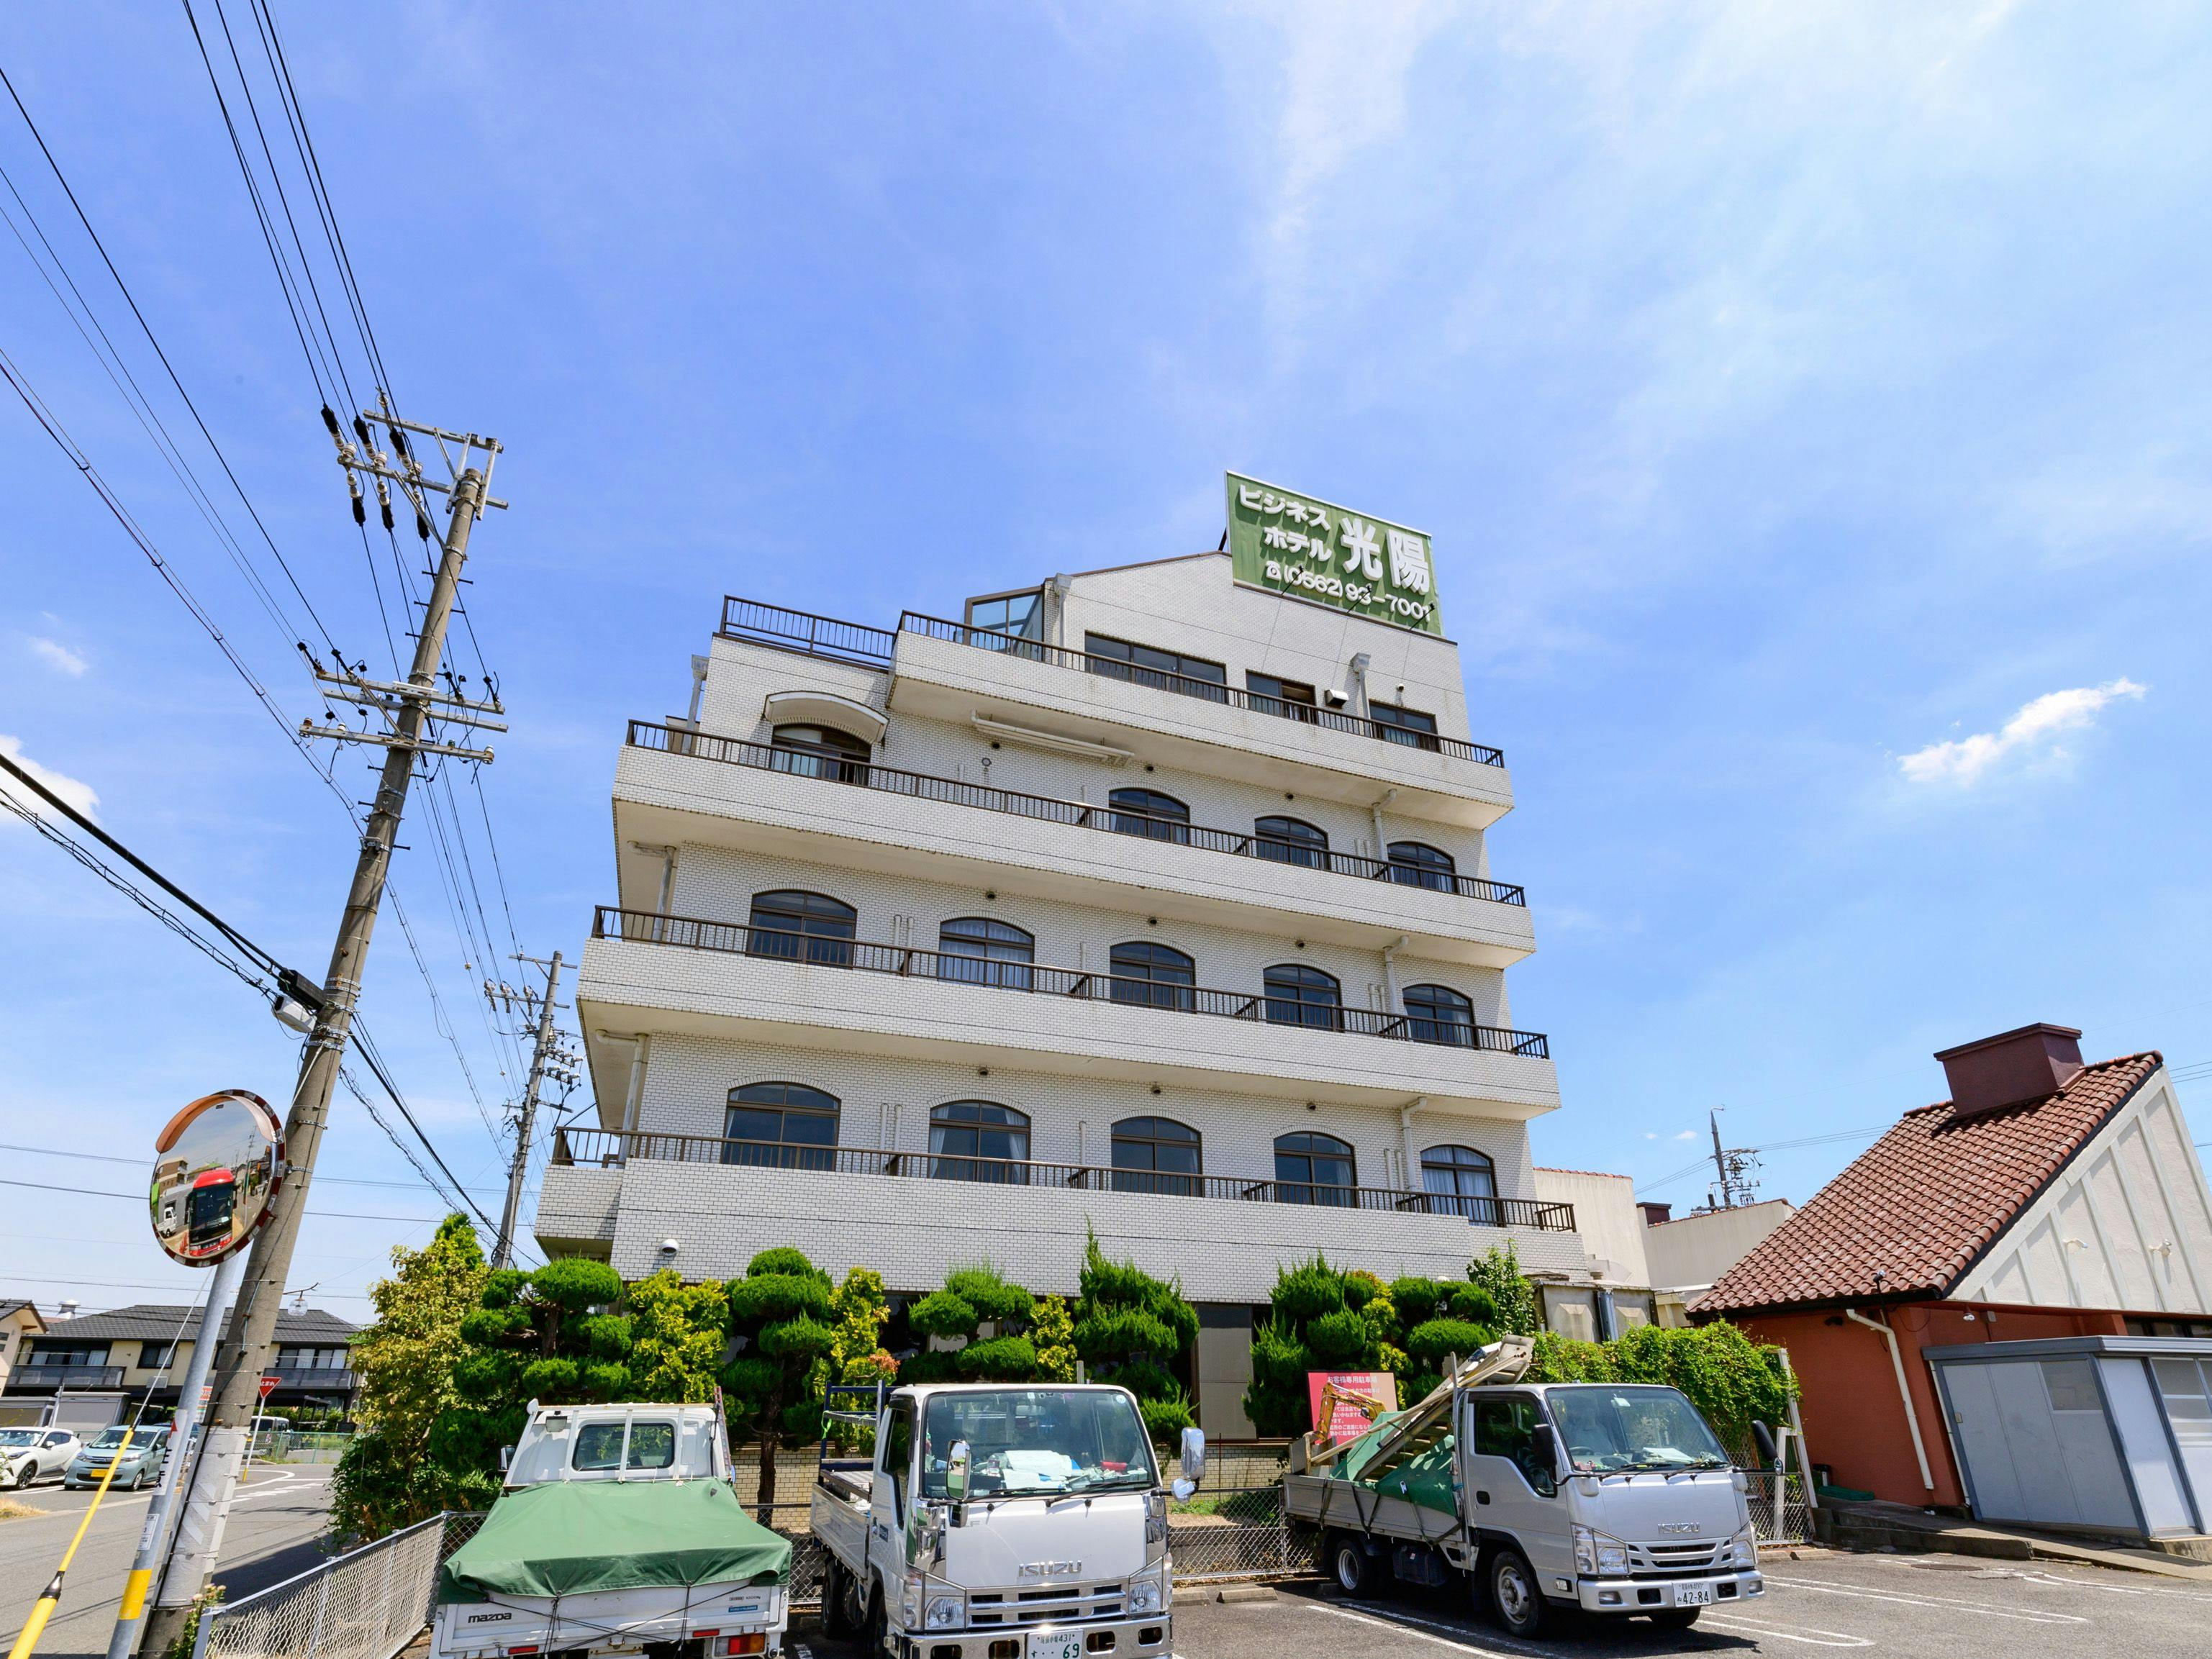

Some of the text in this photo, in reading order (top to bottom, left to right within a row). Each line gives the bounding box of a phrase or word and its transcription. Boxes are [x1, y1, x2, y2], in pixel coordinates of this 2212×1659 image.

[1240, 484, 1331, 531] ビジネス
[1264, 526, 1332, 562] ホテル
[1340, 517, 1430, 596] 光陽
[1657, 1522, 1700, 1534] ISUZU
[1018, 1560, 1082, 1577] ISUZU
[1683, 1591, 1709, 1604] 42-84
